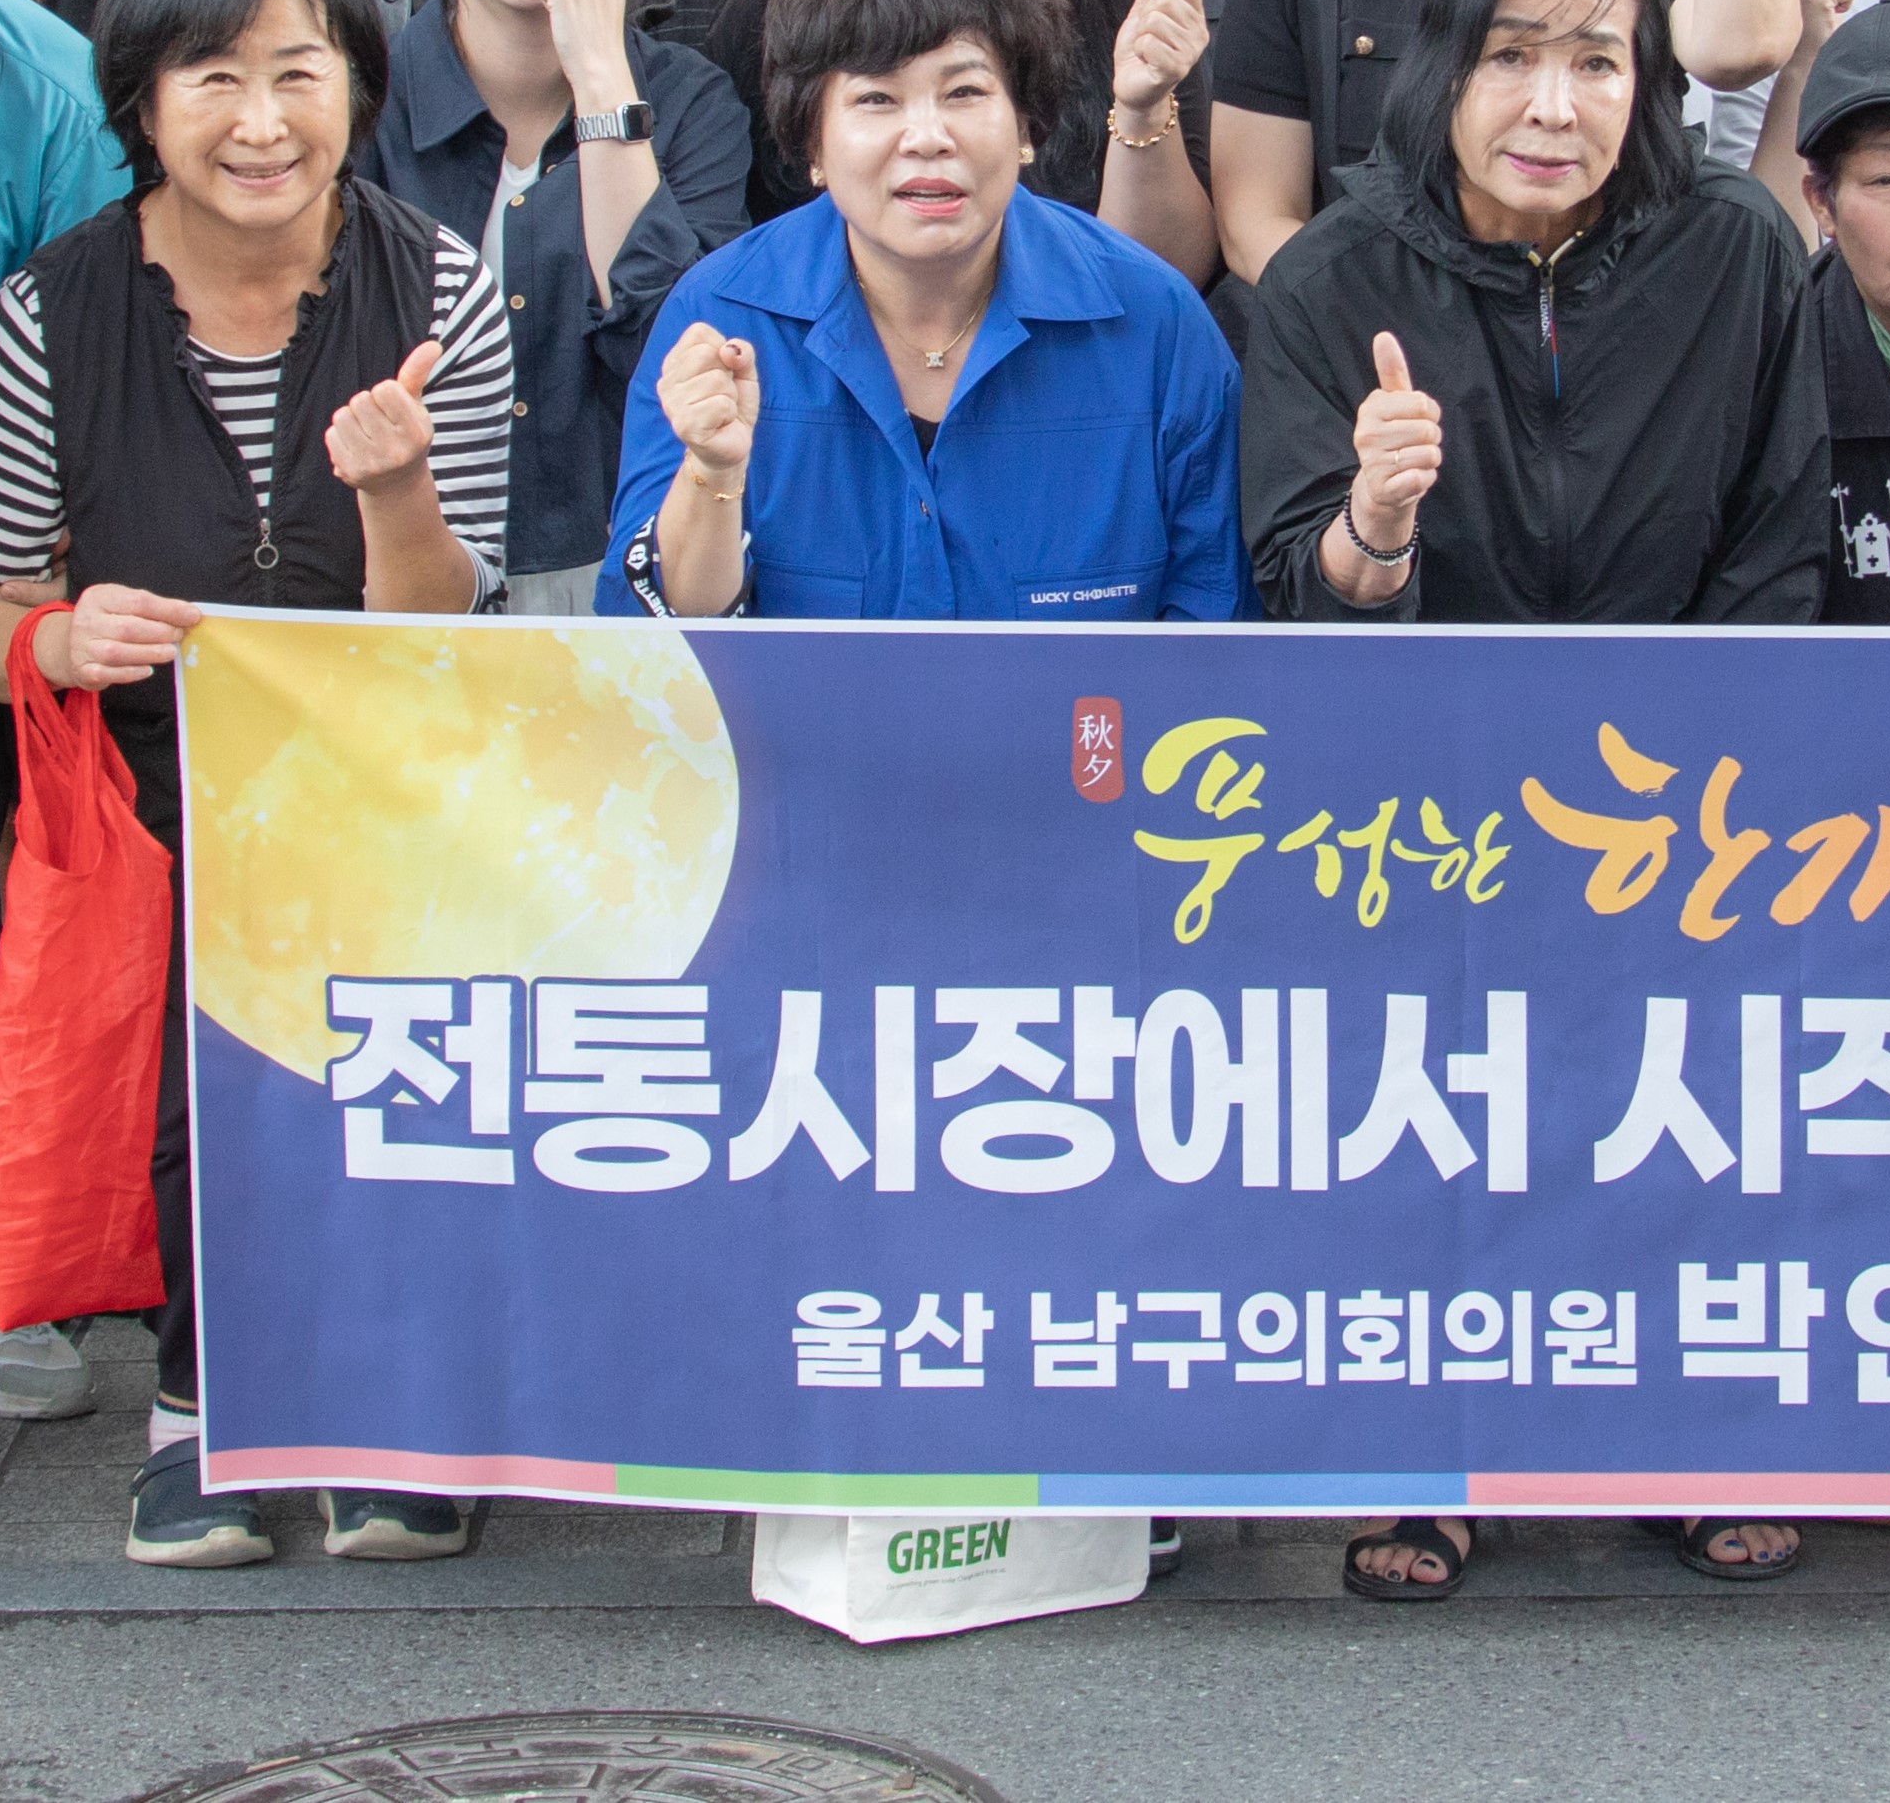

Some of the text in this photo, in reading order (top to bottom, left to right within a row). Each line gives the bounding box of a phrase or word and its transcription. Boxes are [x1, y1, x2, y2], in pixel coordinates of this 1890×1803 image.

[1031, 590, 1069, 605] LUCKY
[1079, 712, 1114, 788] 秋夕
[1135, 717, 1510, 943] 풍성한
[329, 975, 1528, 1193] 전통시장에서
[791, 1289, 994, 1387] 울산
[1029, 1289, 1637, 1389] 남구의회의원
[887, 1518, 1010, 1574] GREEN
